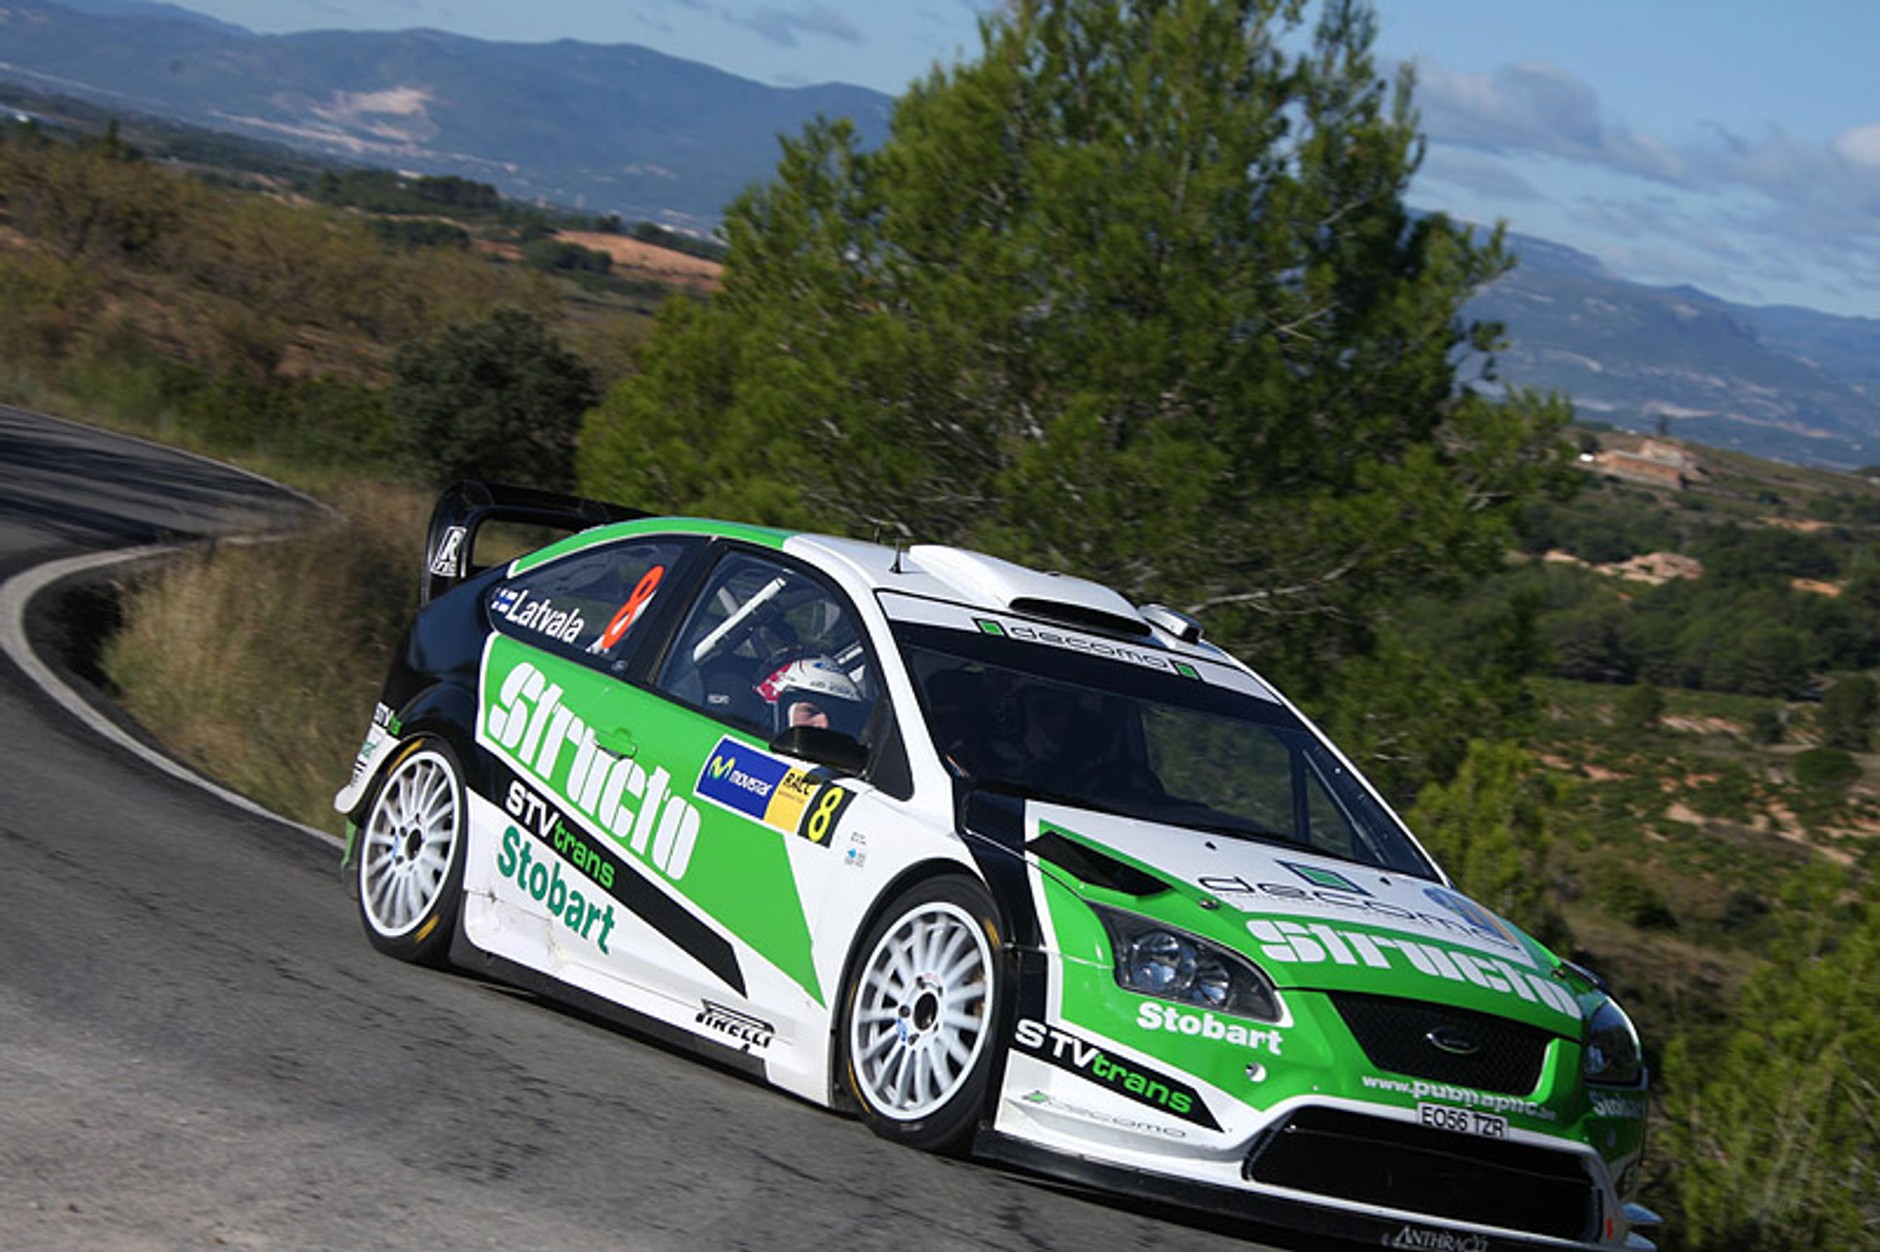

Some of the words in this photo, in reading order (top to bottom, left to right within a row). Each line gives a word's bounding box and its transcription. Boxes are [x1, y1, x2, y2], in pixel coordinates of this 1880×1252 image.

[505, 589, 585, 644] Latvala
[602, 565, 665, 649] 8
[488, 662, 701, 881] Structo
[505, 780, 616, 889] STVtrans
[808, 786, 845, 843] 8
[497, 825, 616, 955] Stobart
[1245, 919, 1583, 1020] Structo
[695, 998, 775, 1049] PIRELLI
[1136, 1001, 1284, 1055] Stobart
[1014, 1018, 1194, 1114] STVtrans
[1420, 1106, 1469, 1131] EO56
[1472, 1113, 1505, 1138] TZR
